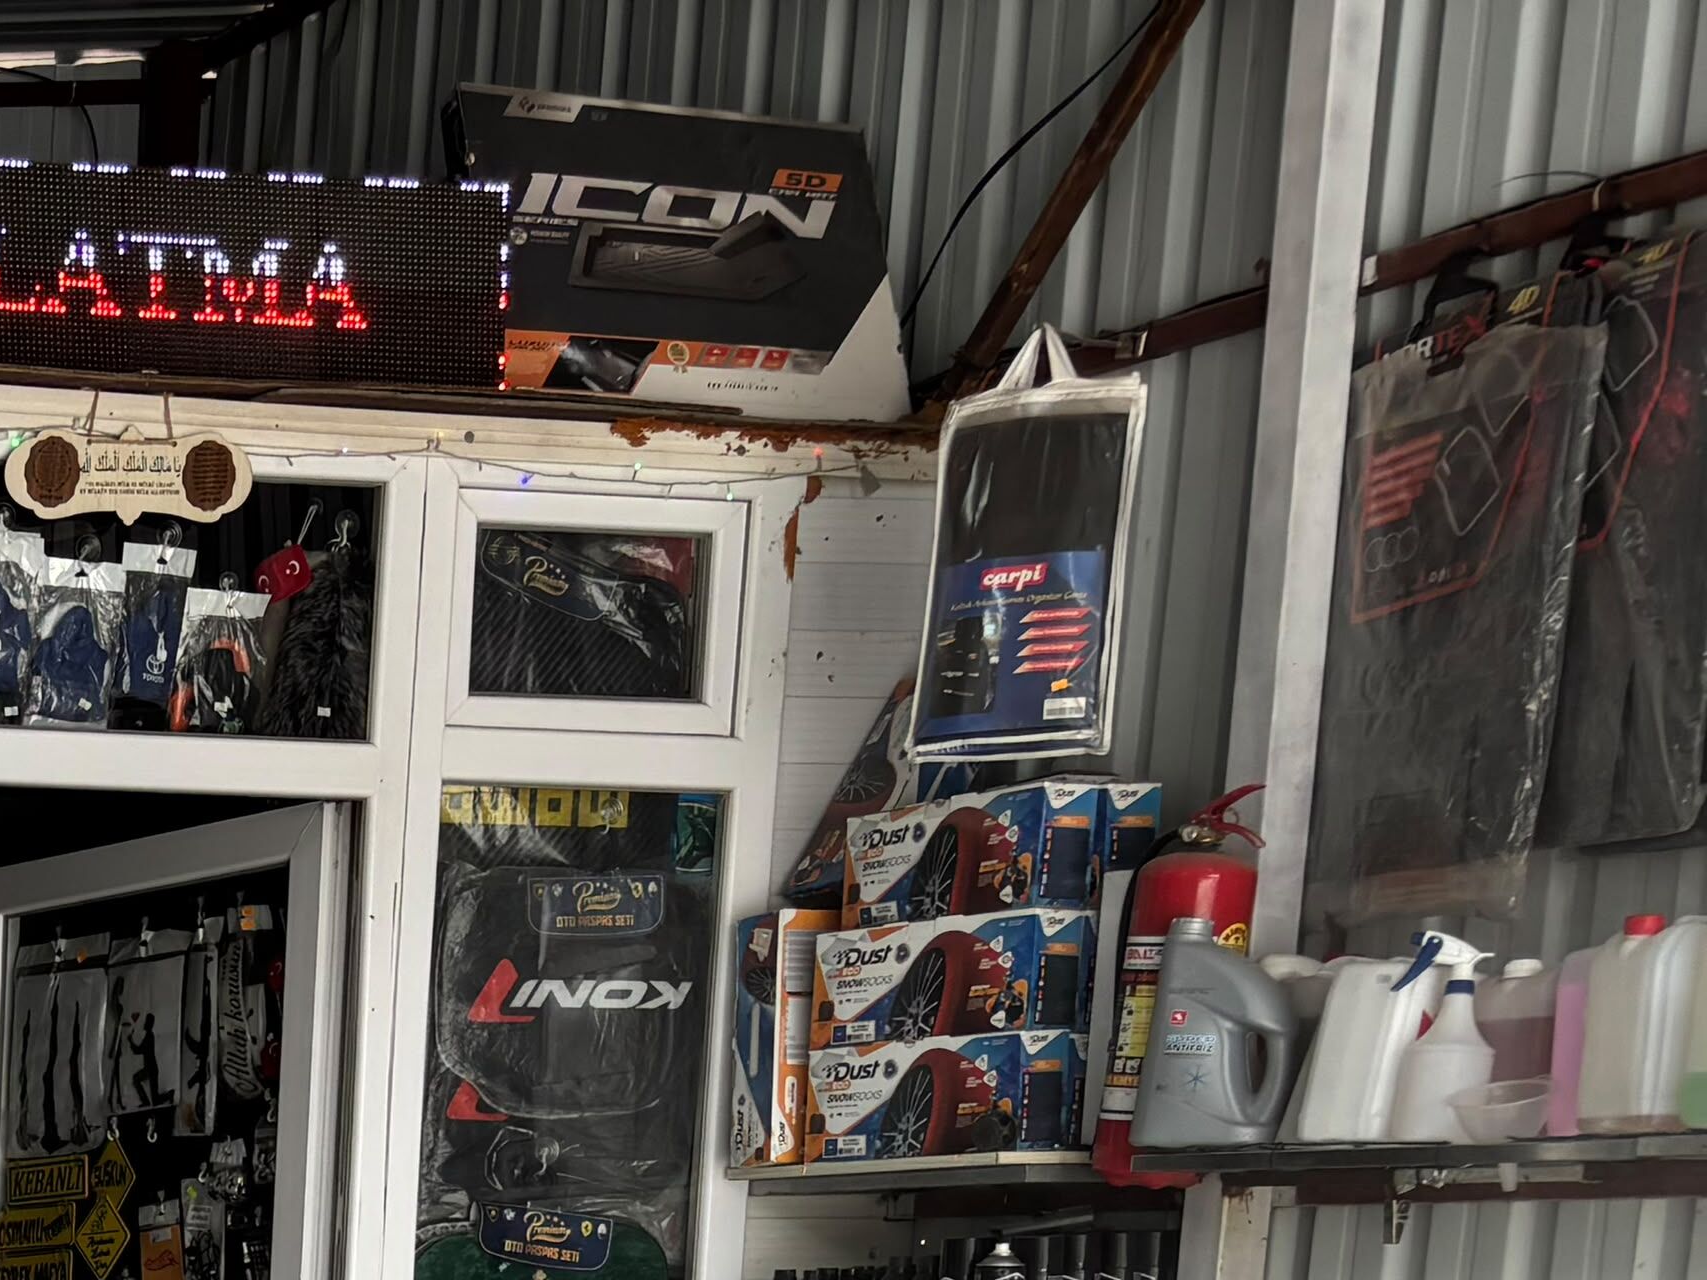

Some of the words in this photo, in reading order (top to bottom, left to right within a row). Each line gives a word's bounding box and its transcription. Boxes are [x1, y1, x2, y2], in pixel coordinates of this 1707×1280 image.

[783, 173, 829, 189] 5D
[516, 172, 837, 240] ICON
[982, 564, 1043, 593] carpi
[868, 824, 909, 849] Dust
[844, 945, 893, 967] Dust
[223, 942, 247, 1022] korusun
[509, 978, 694, 1010] KONI
[836, 975, 894, 990] SNOWSOCKS
[222, 1024, 256, 1093] Allah
[835, 1060, 881, 1081] Dust
[827, 1090, 883, 1103] SNOWSOCKS
[12, 1166, 82, 1197] KEBANLI
